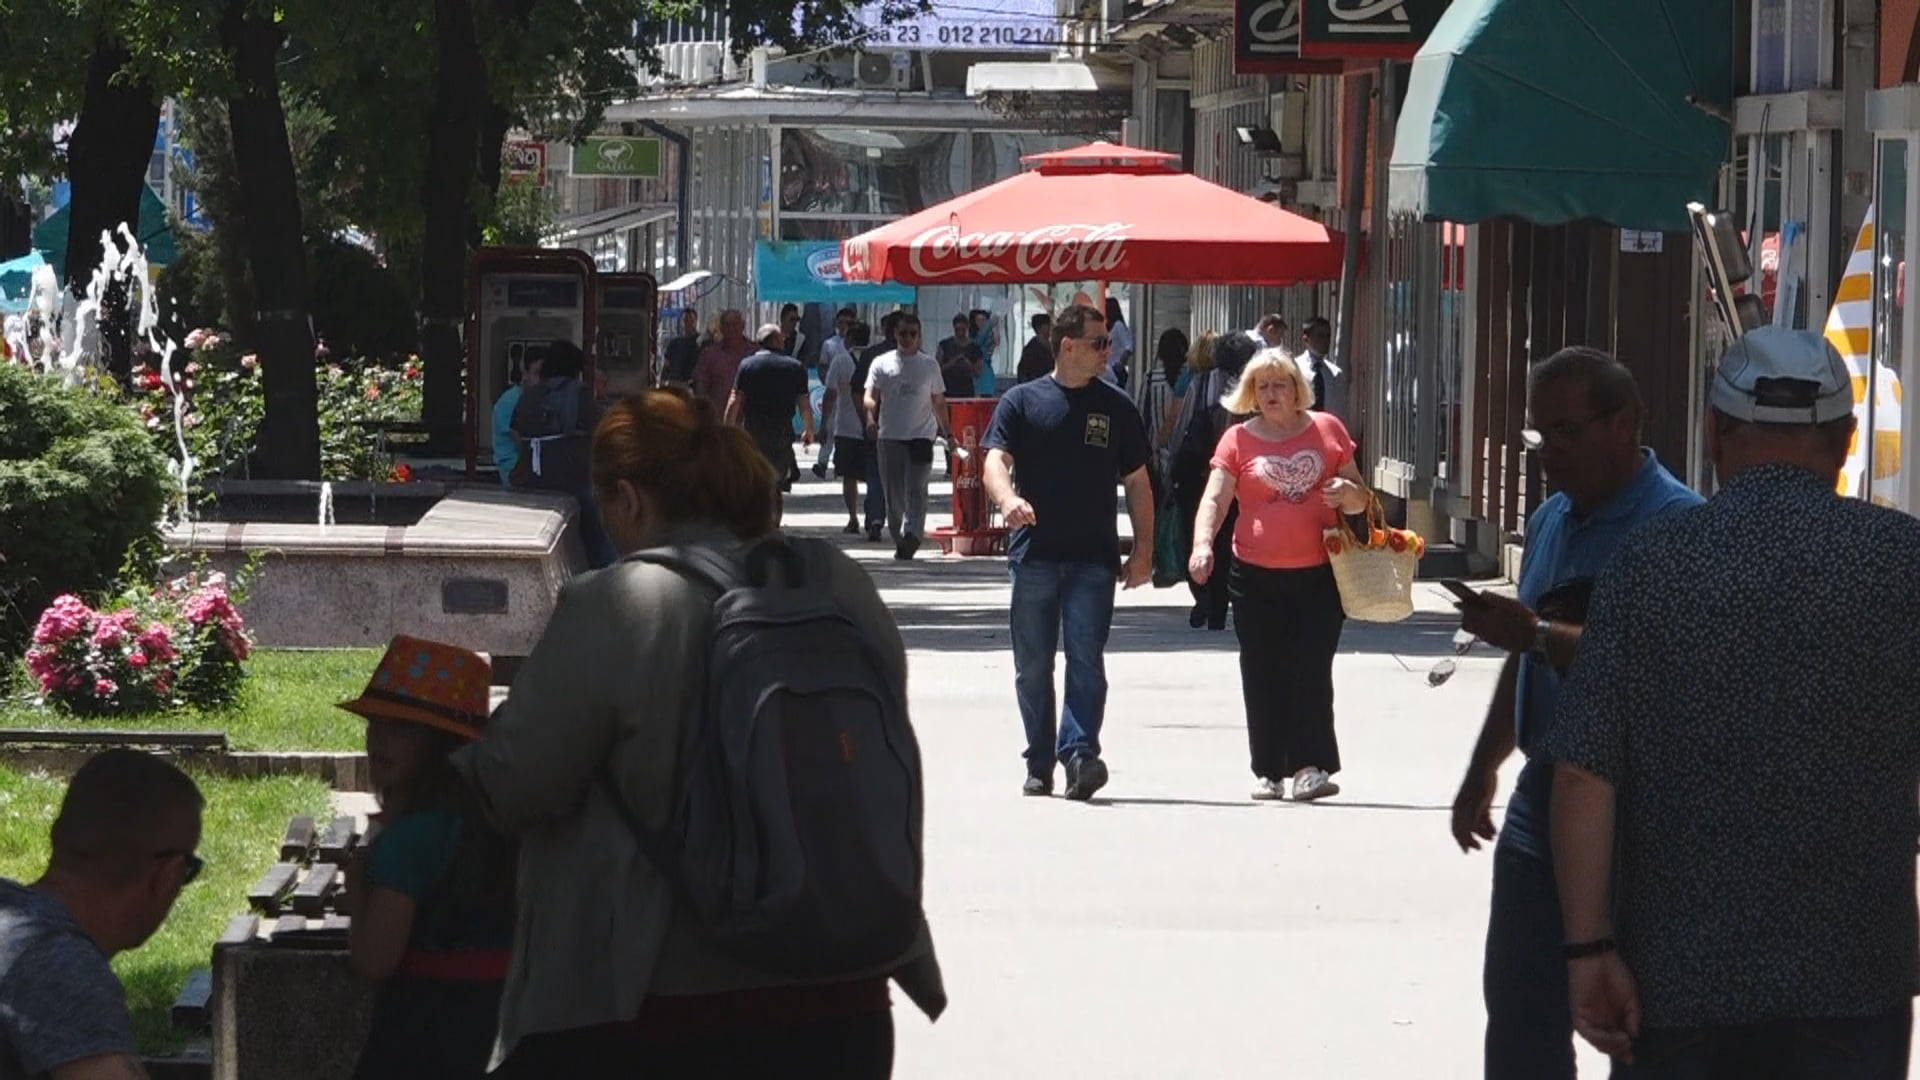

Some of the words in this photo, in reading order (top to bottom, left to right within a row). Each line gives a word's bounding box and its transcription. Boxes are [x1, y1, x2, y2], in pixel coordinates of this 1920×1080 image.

[897, 25, 920, 42] 23
[938, 25, 973, 43] 012
[979, 26, 1014, 44] 210
[909, 222, 1135, 277] Coca-Cola
